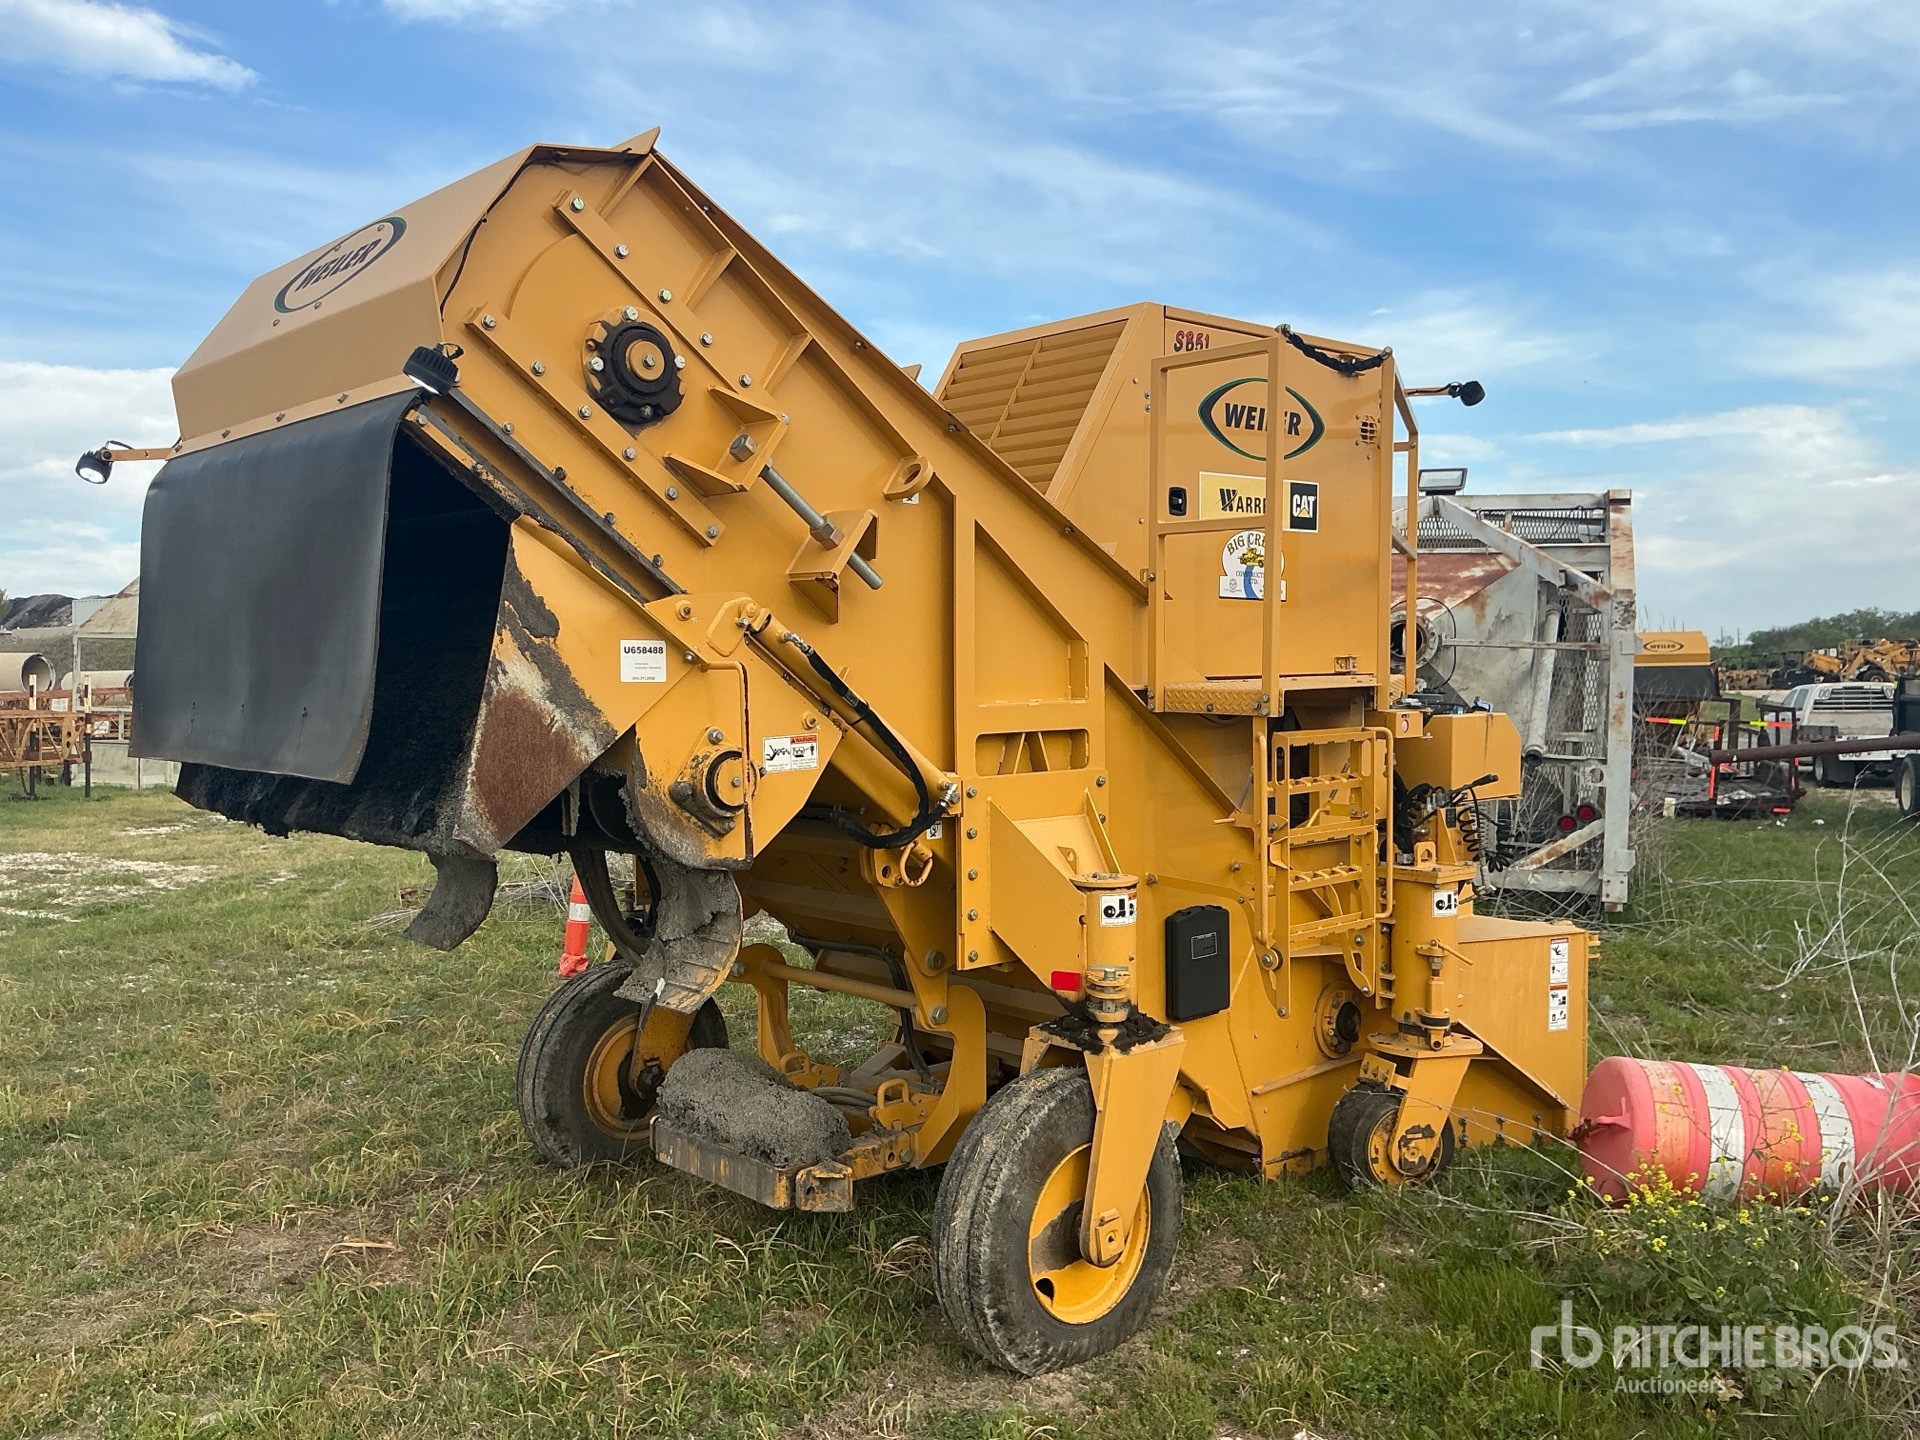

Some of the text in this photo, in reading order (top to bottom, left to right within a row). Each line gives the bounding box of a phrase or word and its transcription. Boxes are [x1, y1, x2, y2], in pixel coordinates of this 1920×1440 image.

[294, 238, 383, 293] WEILER
[1174, 330, 1210, 352] SB51
[1225, 403, 1302, 436] WEIR
[1292, 494, 1316, 518] CAT
[1227, 535, 1245, 556] BIG
[623, 646, 664, 654] U658488
